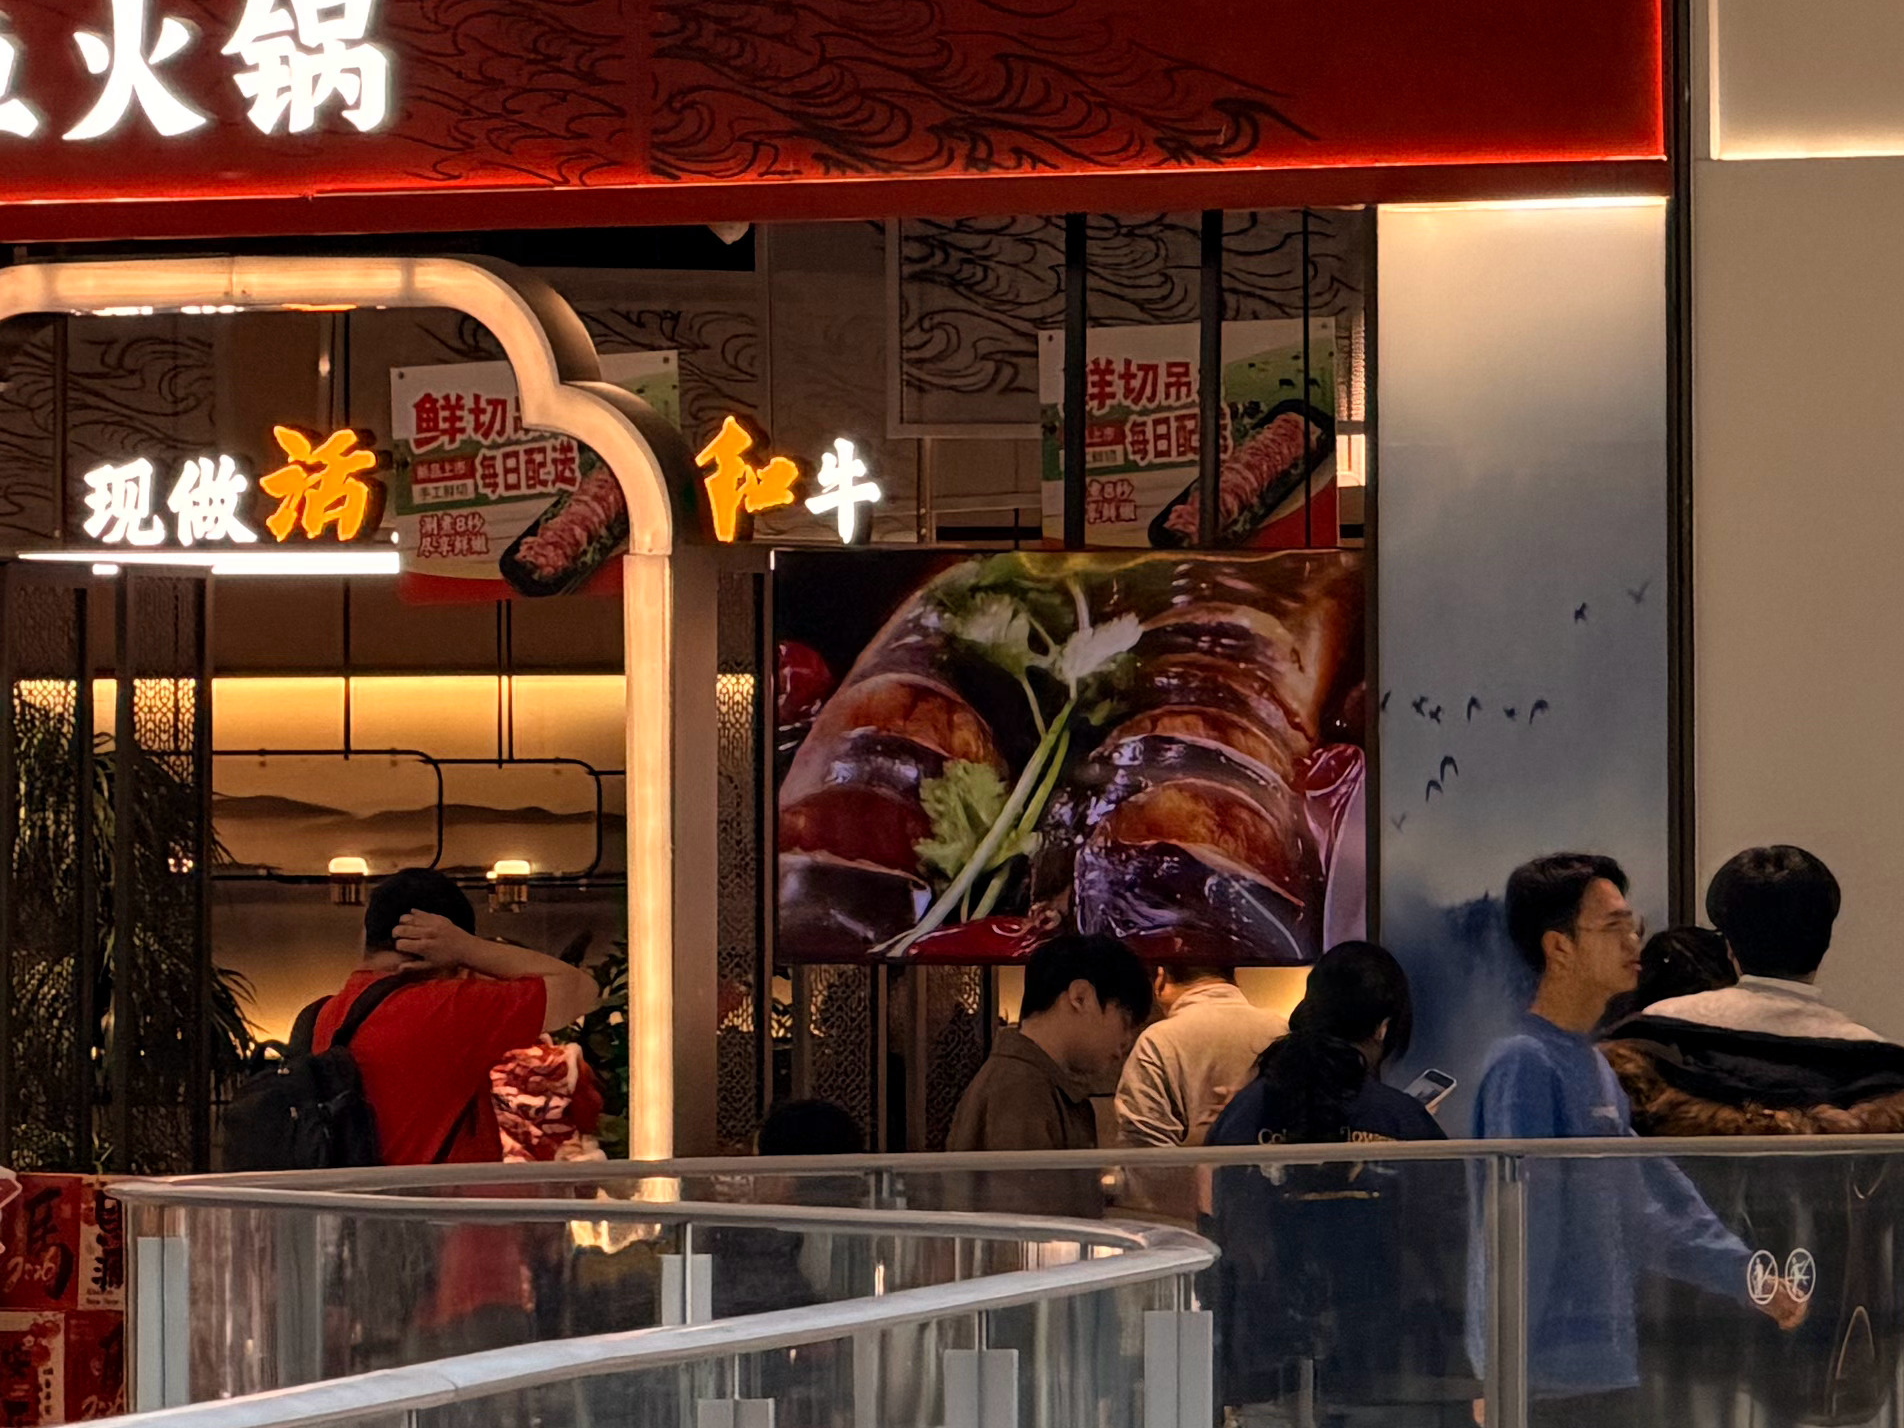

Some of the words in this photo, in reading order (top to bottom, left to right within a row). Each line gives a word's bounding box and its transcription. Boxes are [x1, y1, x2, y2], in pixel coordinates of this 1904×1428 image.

[414, 392, 521, 451] 鲜切
[1130, 409, 1230, 465] 每日配
[480, 438, 578, 495] 每日配送
[695, 415, 881, 545] 和牛
